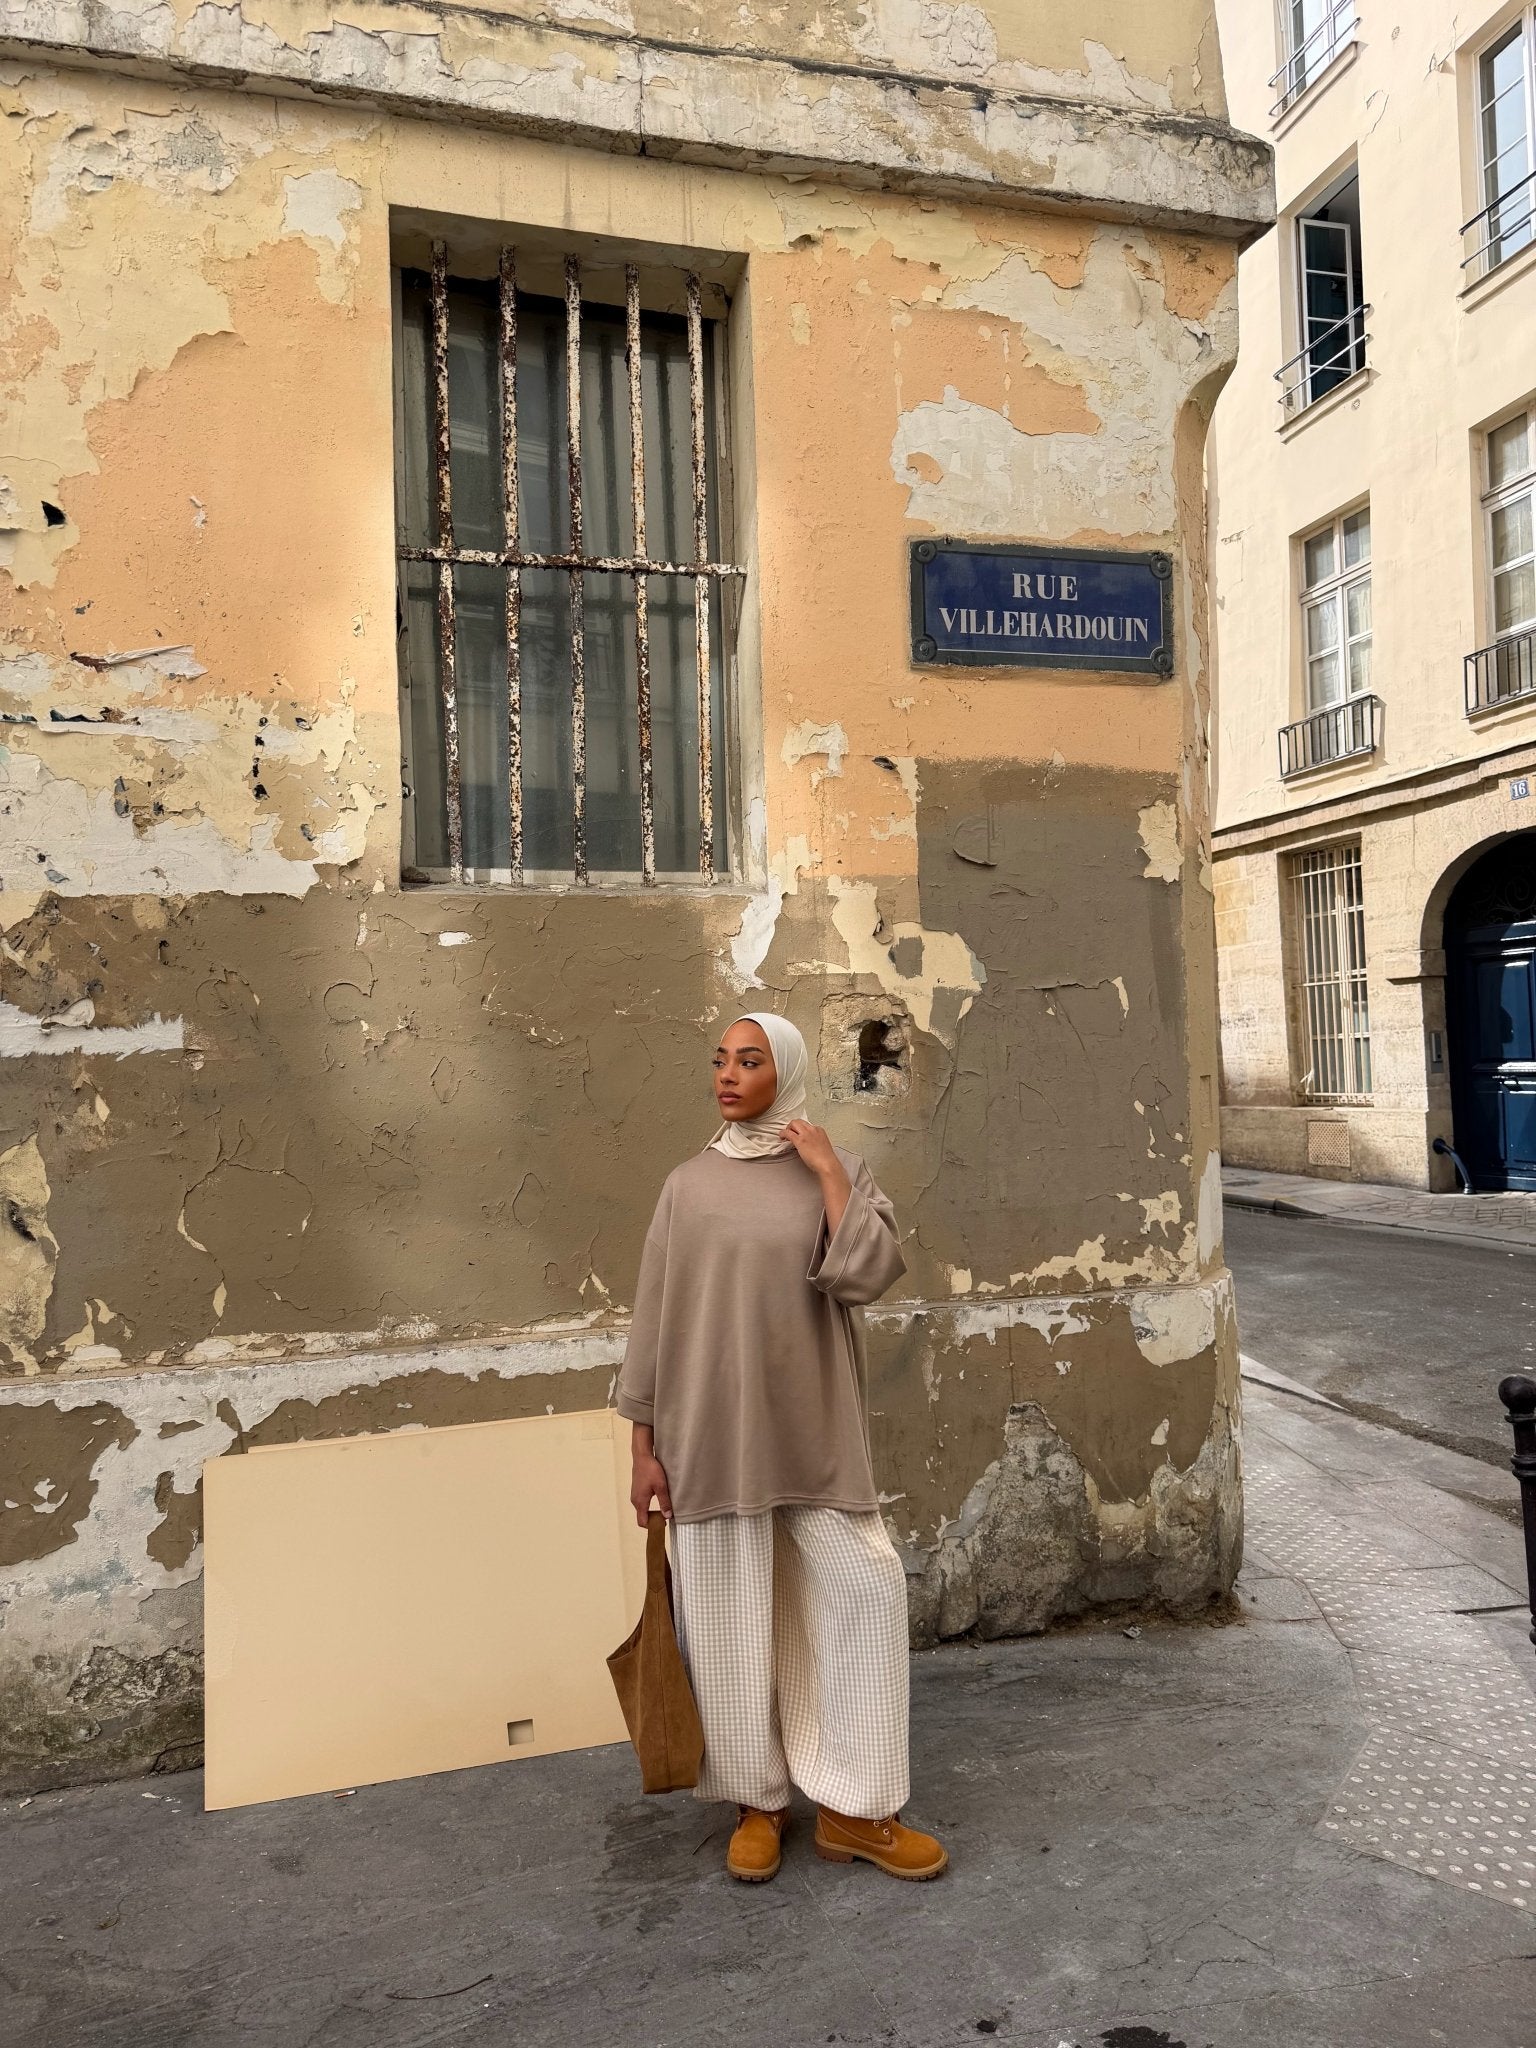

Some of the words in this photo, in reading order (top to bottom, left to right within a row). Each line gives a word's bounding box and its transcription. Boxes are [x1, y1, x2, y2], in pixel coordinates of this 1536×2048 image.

[1012, 572, 1078, 601] RUE
[939, 607, 1149, 642] VILLEHARDOUIN
[1513, 782, 1527, 797] 16
